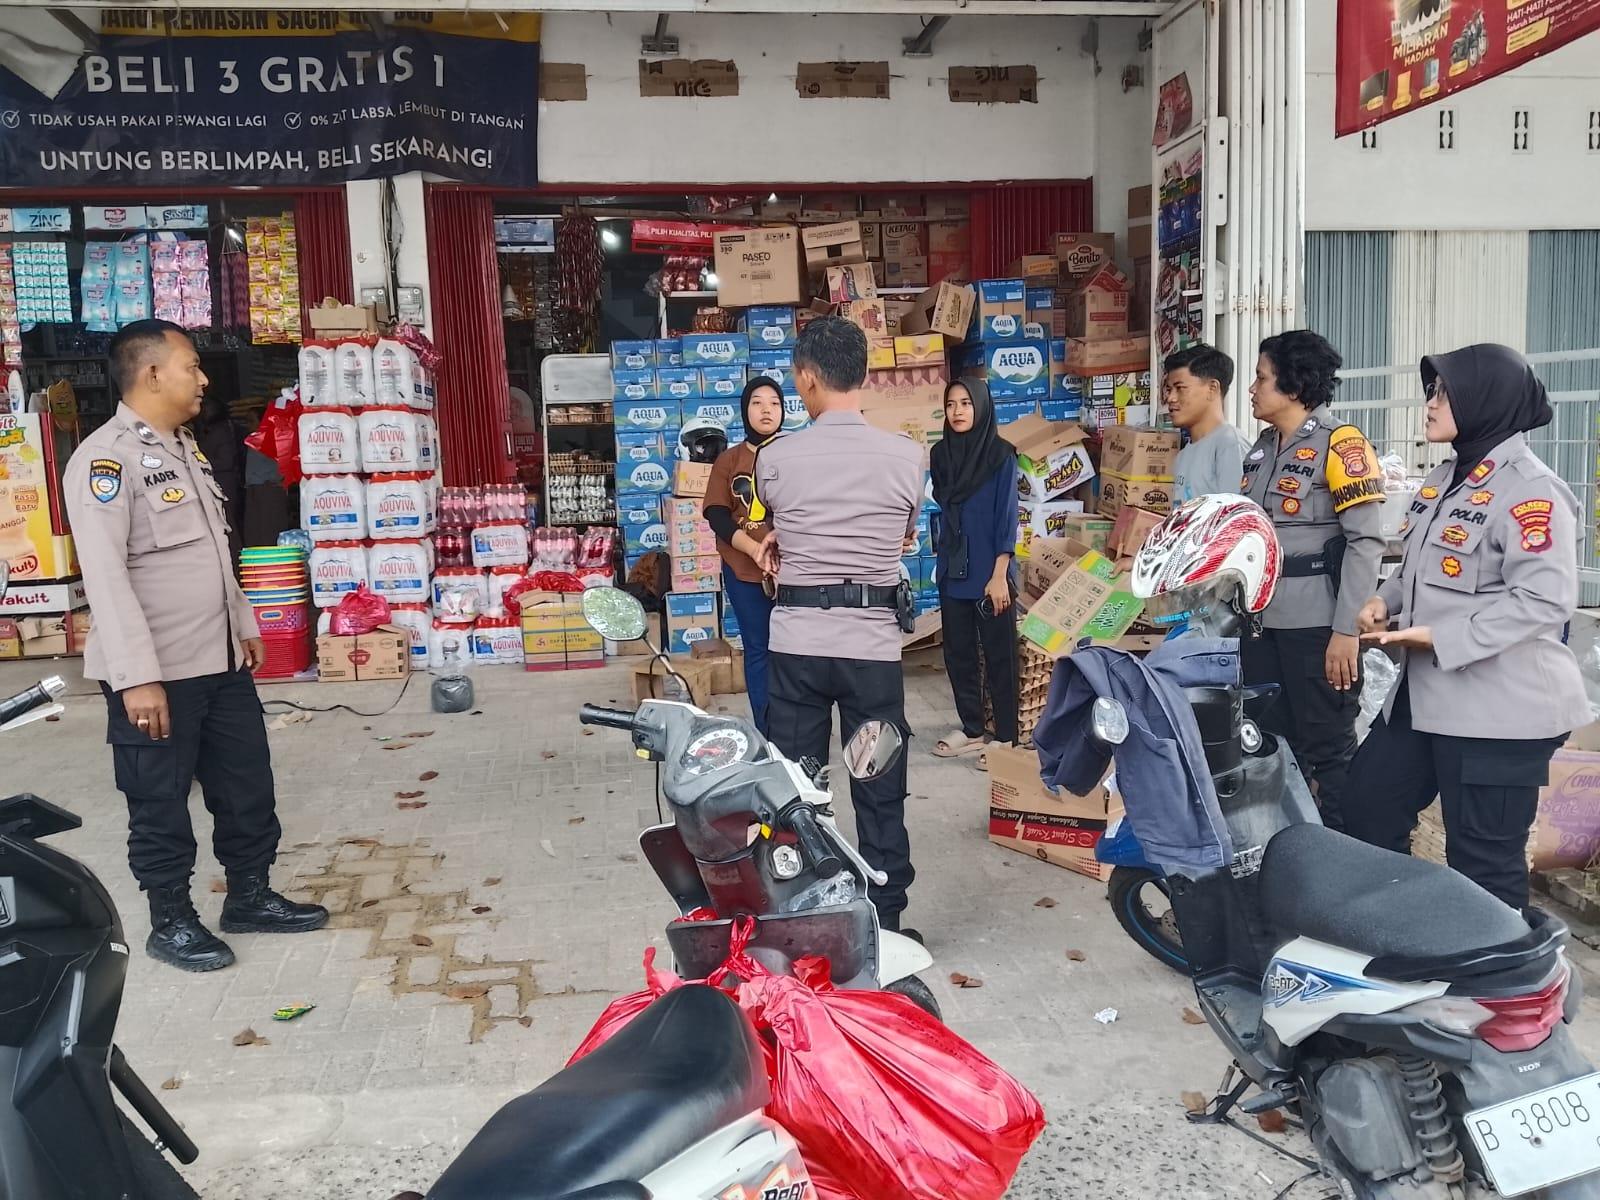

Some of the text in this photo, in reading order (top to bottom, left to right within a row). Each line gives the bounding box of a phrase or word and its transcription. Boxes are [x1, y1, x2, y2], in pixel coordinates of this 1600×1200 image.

[1393, 23, 1449, 60] MILIARAN
[1404, 45, 1436, 67] HADIAH
[85, 46, 444, 94] BELI 3 GRATIS 1
[29, 113, 73, 127] TIDAK
[78, 115, 117, 127] USAH
[121, 115, 161, 127] PAKAI
[165, 115, 231, 128] PEWANGI
[236, 115, 267, 128] LAGI
[310, 115, 329, 126] 0%
[351, 107, 396, 120] LABSA,
[399, 101, 446, 120] LEMBUT
[452, 110, 465, 122] DI
[470, 112, 524, 130] TANGAN
[40, 135, 493, 172] UNTUNG BERLIMPAH, BELI SEKARANG!
[743, 252, 771, 262] PASEO
[994, 319, 1013, 328] AQUA
[702, 342, 730, 354] AQUA
[999, 352, 1036, 367] AQUA
[633, 409, 661, 420] AQUA
[702, 406, 730, 418] AQUA
[307, 431, 345, 444] AQUVIVA
[368, 430, 406, 443] AQUVIVA
[635, 471, 664, 482] AQUA
[1282, 463, 1315, 479] POLRI
[143, 470, 180, 488] KADEK
[314, 496, 353, 510] AQUVIVA
[379, 498, 416, 513] AQUVIVA
[1449, 509, 1489, 526] POLRI
[491, 537, 519, 548] AQUVIVA
[316, 565, 354, 578] AQUVIVA
[379, 562, 417, 576] AQUVIVA
[685, 631, 705, 641] AQUA
[1051, 829, 1077, 844] Siput
[1476, 1091, 1590, 1151] B 3808
